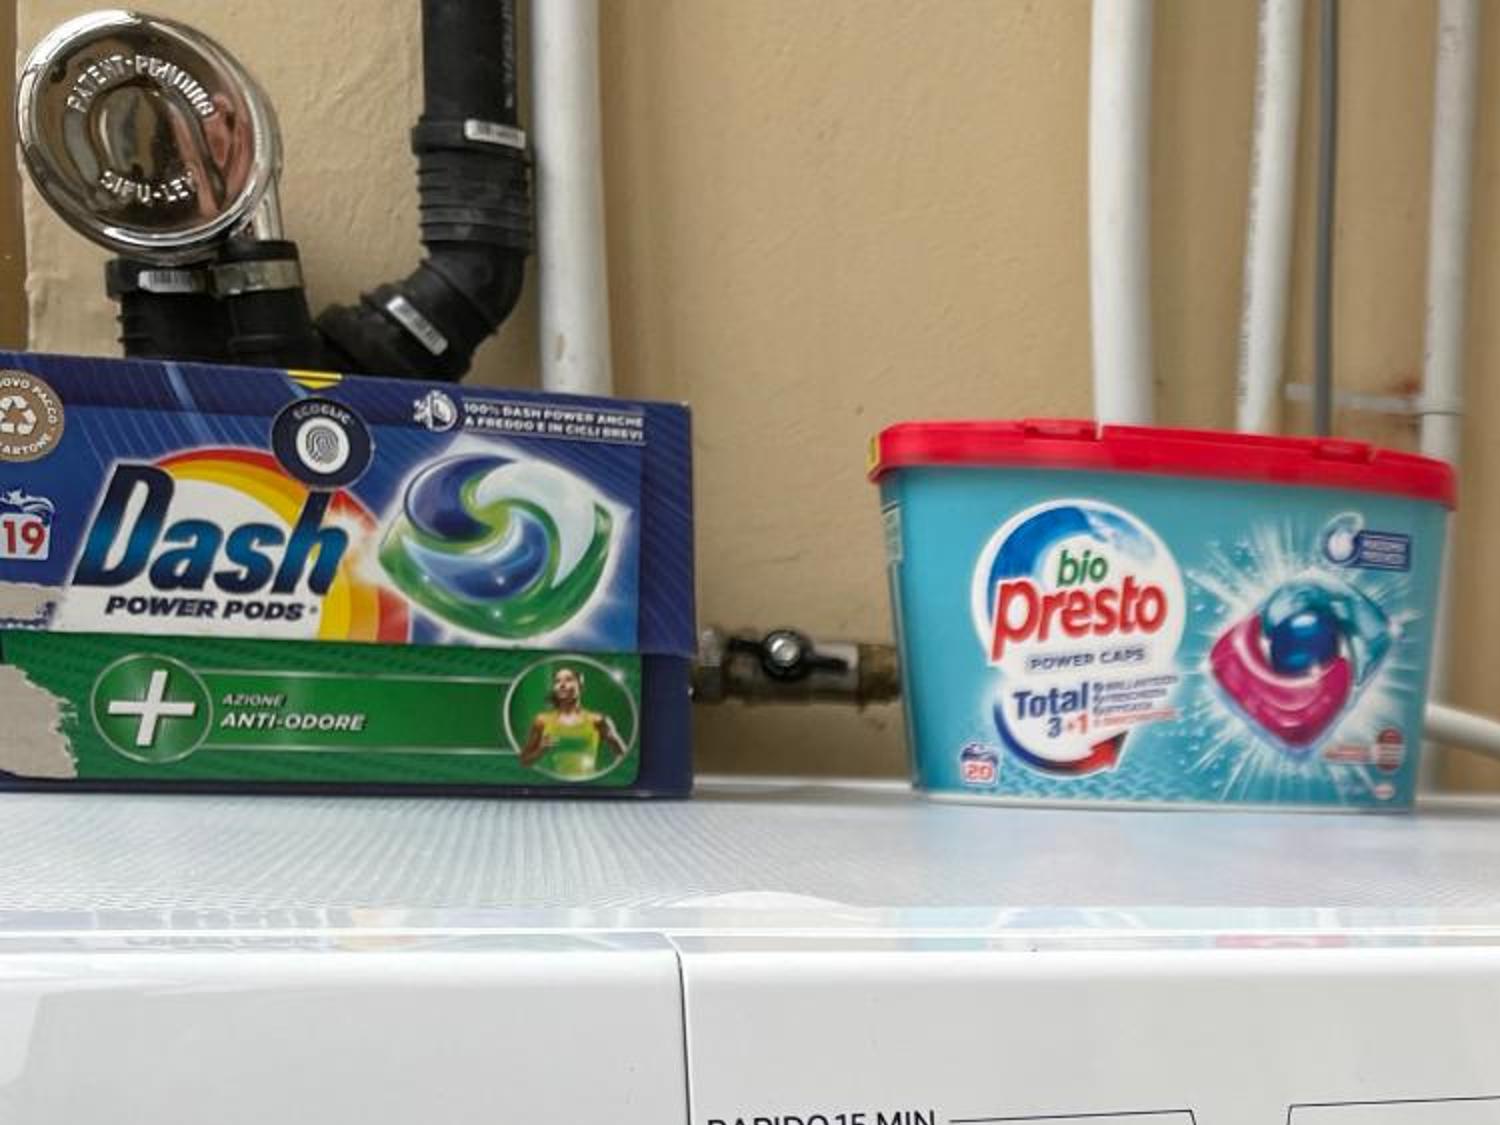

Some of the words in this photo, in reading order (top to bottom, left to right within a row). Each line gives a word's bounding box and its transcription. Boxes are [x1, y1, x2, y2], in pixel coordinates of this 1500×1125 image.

[503, 405, 541, 420] DASH
[543, 409, 594, 424] POWER
[597, 414, 644, 428] ANCHE
[477, 418, 534, 432] FREDDO
[549, 422, 563, 434] IN
[565, 424, 600, 438] CICLI
[602, 426, 644, 441] BREVI
[3, 520, 47, 556] 19
[71, 463, 349, 597] Dash
[1056, 547, 1109, 589] bio
[105, 594, 219, 619] POWER
[222, 599, 306, 621] PODS
[1030, 650, 1095, 671] POWER
[1100, 647, 1146, 665] CAPS
[221, 692, 287, 708] AZIONE
[1013, 682, 1089, 720] Total
[219, 711, 367, 732] ANTI-ODORE
